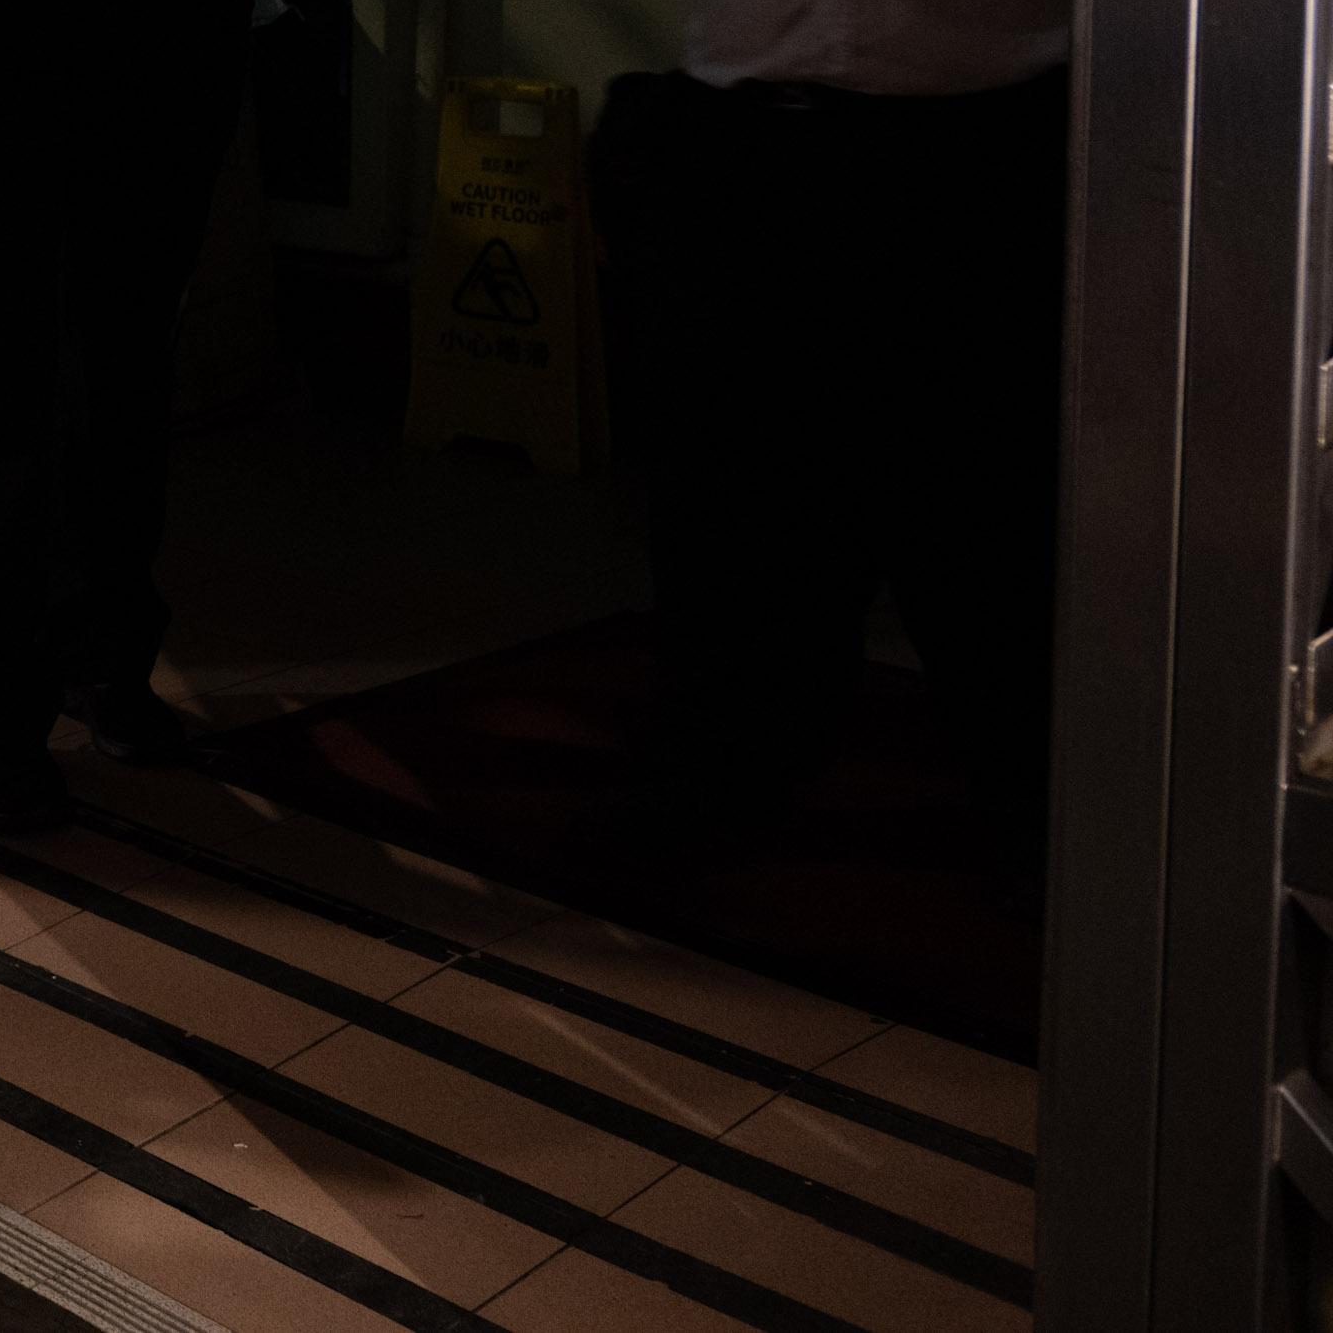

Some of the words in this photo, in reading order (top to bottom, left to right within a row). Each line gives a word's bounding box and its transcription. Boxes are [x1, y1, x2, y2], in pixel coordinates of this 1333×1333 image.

[462, 182, 541, 206] CAUTION
[450, 200, 487, 219] WET
[491, 205, 551, 227] FLOOR
